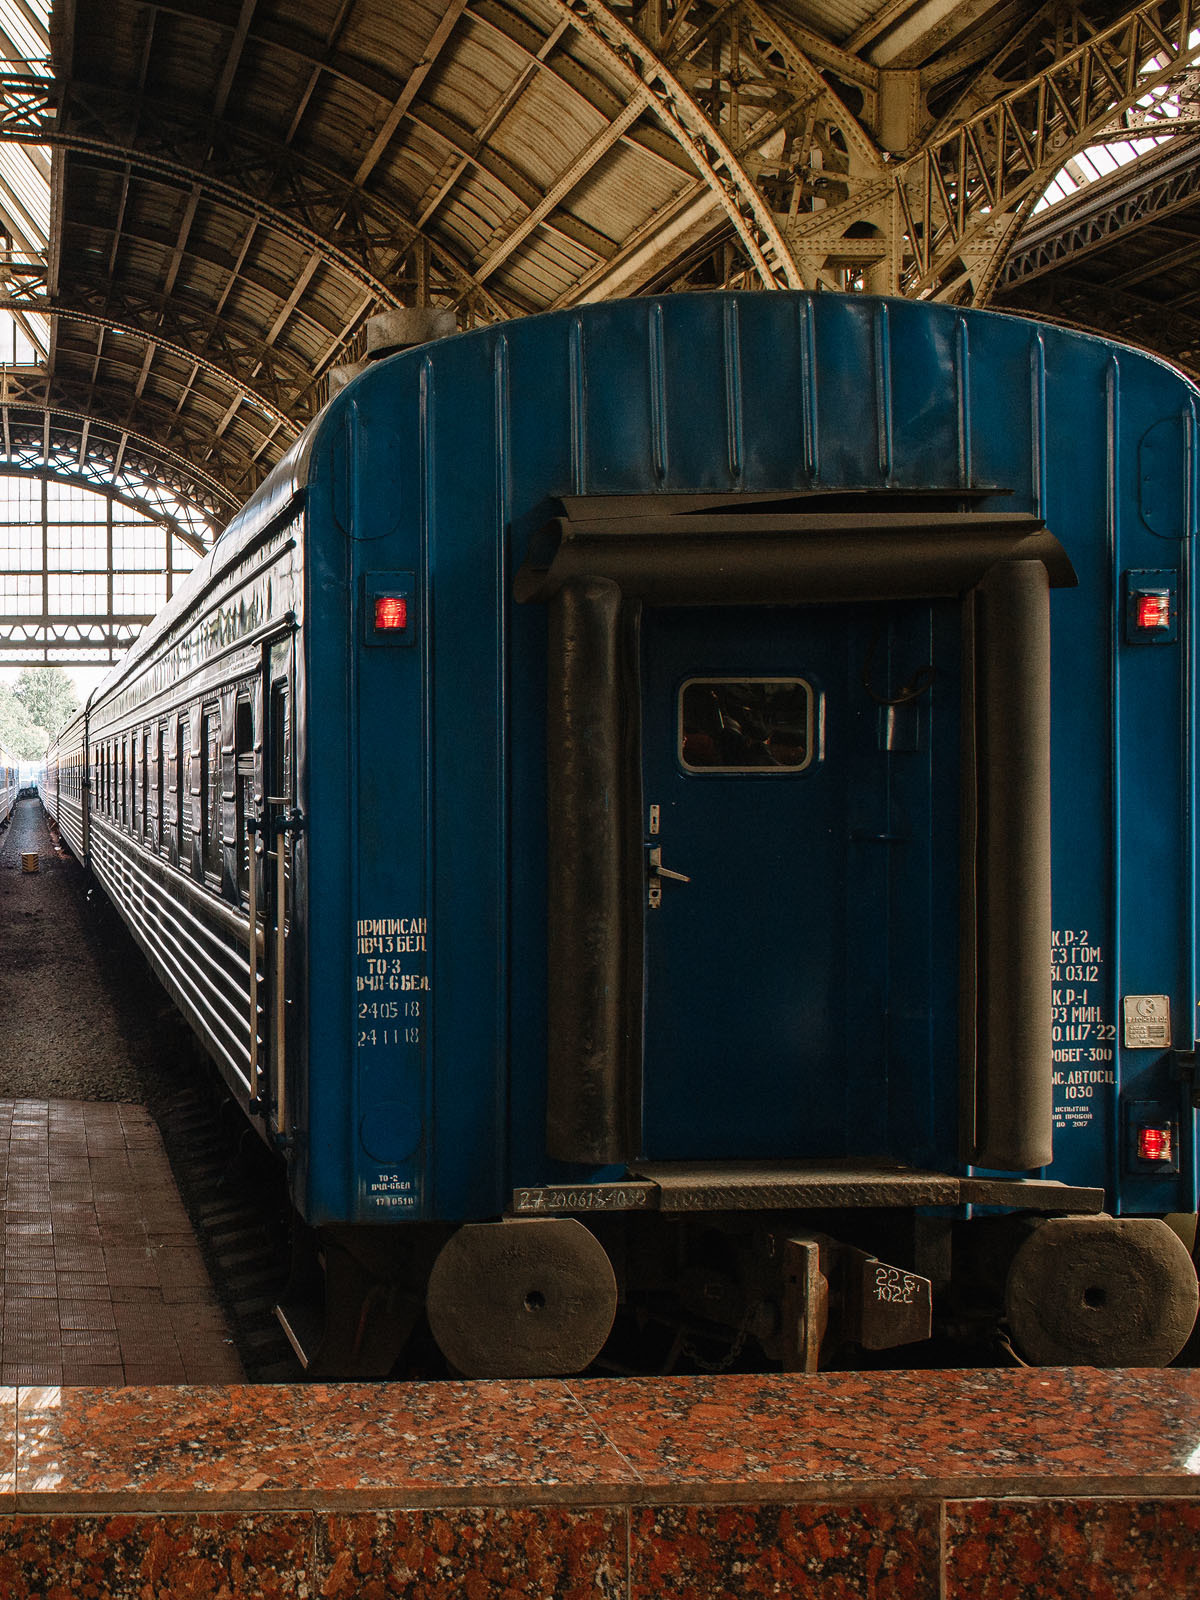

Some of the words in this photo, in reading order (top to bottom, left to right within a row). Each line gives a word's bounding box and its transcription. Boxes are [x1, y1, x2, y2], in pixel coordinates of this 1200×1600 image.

[356, 917, 427, 937] ПРИПИСАН
[1071, 947, 1103, 964] ГОМ.
[367, 958, 401, 975] ТО-3
[1065, 1085, 1094, 1100] 1030
